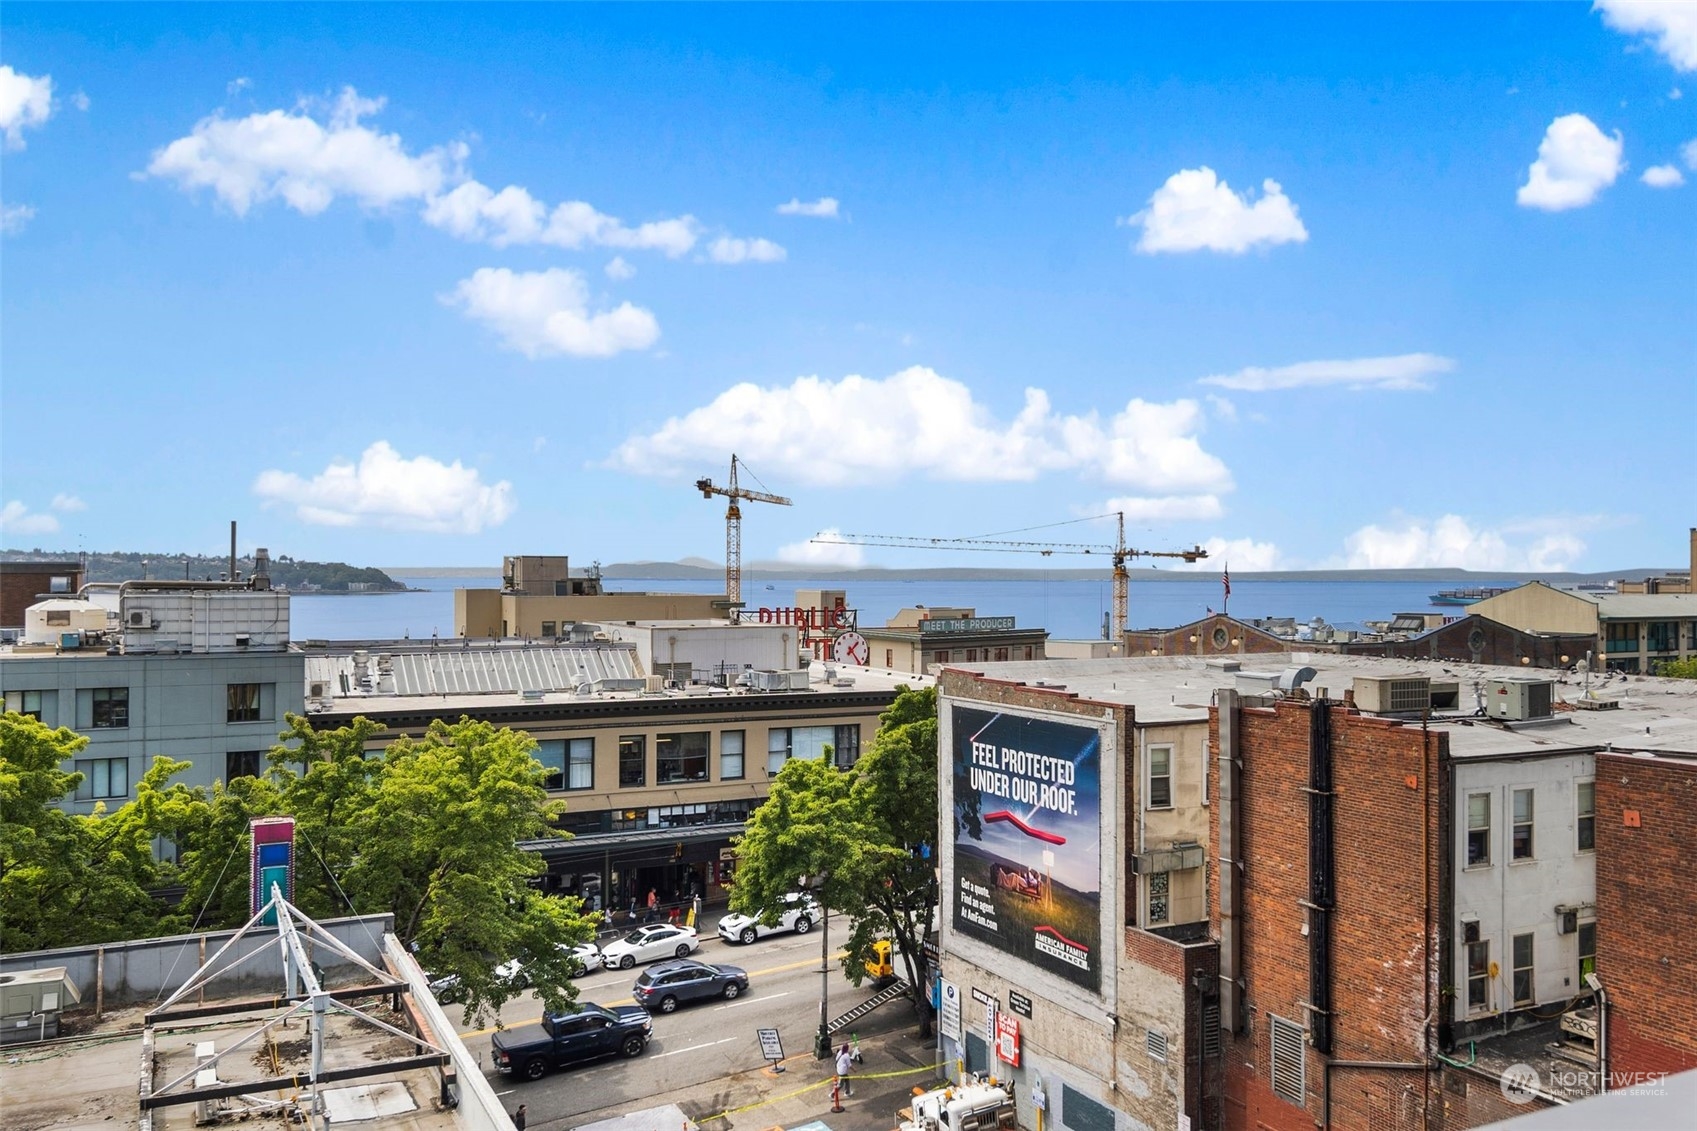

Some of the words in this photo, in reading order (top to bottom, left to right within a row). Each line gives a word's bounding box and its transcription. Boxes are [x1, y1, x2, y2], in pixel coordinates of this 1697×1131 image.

[759, 606, 847, 631] PUBLIC
[923, 620, 945, 632] MEET
[950, 620, 965, 631] THE
[970, 618, 1012, 630] PRODUCER
[972, 742, 999, 769] FEEL
[1001, 747, 1075, 786] PROTECTED
[970, 766, 1010, 799] UNDER
[1012, 776, 1038, 806] OUR
[1040, 783, 1078, 816] ROOF.
[961, 876, 970, 890] Get
[970, 883, 974, 893] a
[974, 884, 990, 898] quote.
[961, 890, 972, 906] Find
[972, 898, 979, 909] an
[979, 901, 996, 916] agent.
[961, 906, 967, 918] At
[967, 909, 998, 931] AmFam.com
[1035, 932, 1065, 952] AMERICAN
[1065, 944, 1088, 961] FAMILY
[1037, 942, 1084, 966] INSURANCE
[998, 1012, 1018, 1030] SCAN
[998, 1022, 1007, 1032] TO
[1007, 1025, 1018, 1036] PAY
